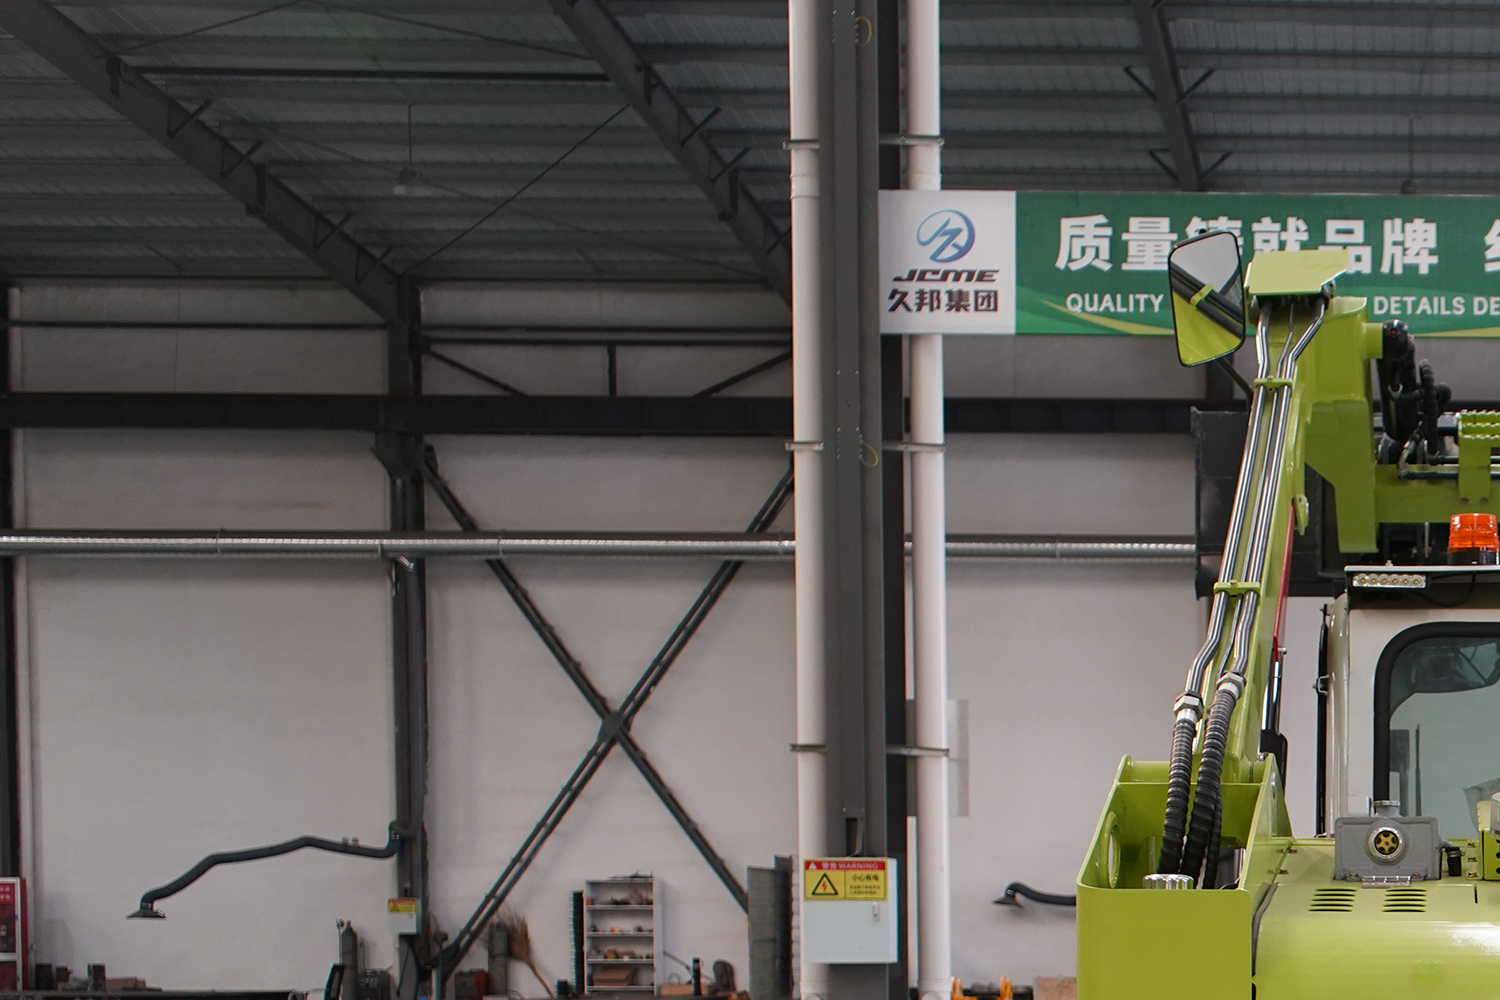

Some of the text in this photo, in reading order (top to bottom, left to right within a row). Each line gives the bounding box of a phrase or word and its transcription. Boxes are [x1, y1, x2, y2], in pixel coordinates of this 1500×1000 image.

[892, 268, 1000, 282] JCME
[888, 288, 998, 312] 久邦集团
[1066, 293, 1164, 314] QUALITY
[1373, 296, 1465, 316] DETAILS
[838, 861, 879, 870] WARNING
